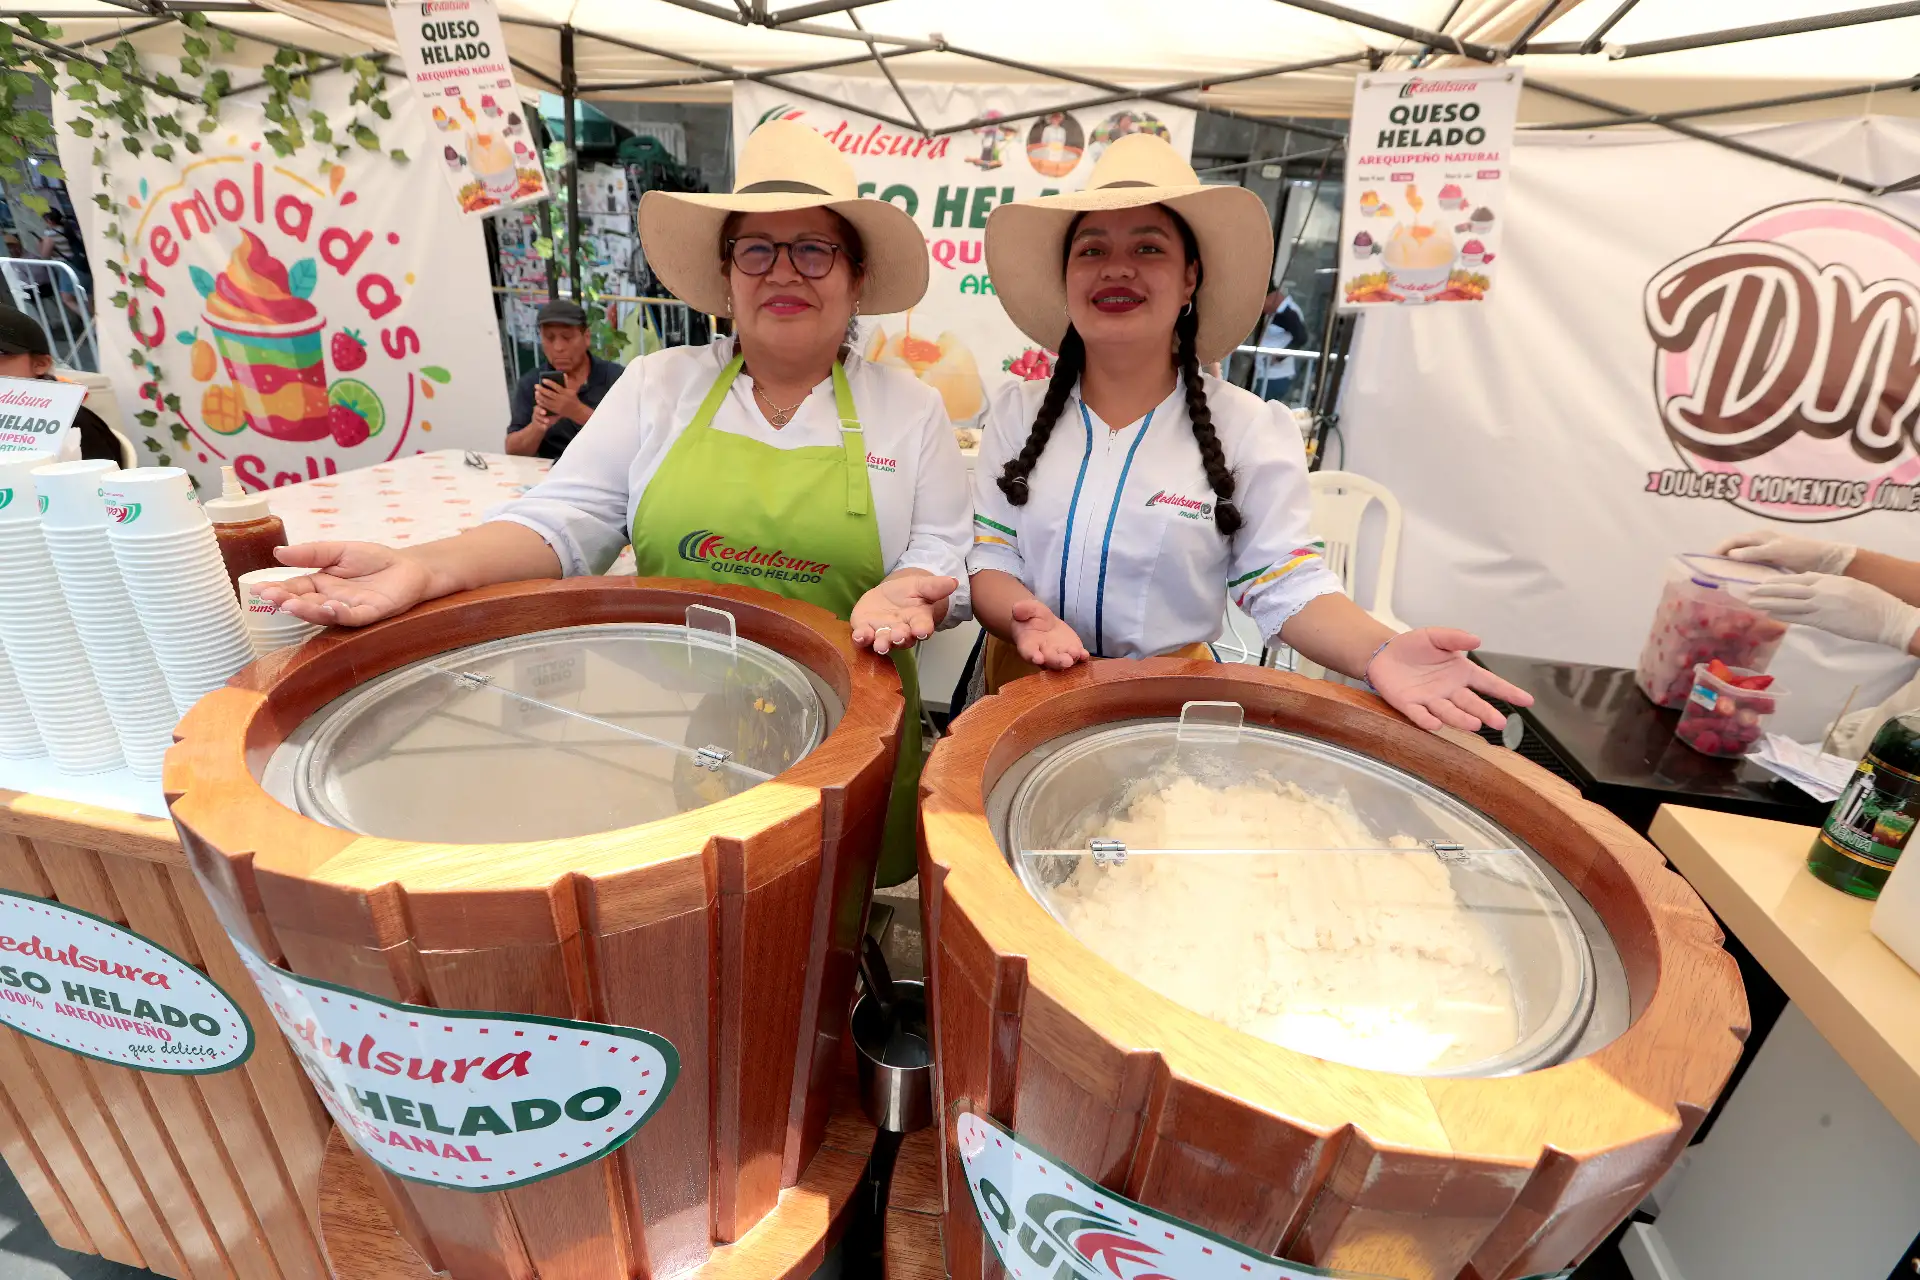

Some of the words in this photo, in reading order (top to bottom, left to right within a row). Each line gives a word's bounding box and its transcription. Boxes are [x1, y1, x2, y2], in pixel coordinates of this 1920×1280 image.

[421, 20, 480, 42] QUESO
[420, 41, 490, 65] HELADO
[1389, 102, 1481, 126] QUESO
[1377, 126, 1486, 149] HELADO
[1358, 154, 1440, 167] AREQUIPEÑO
[1657, 469, 1743, 501] DULCES
[1749, 474, 1868, 508] MOMENTOS
[699, 535, 831, 575] Kedulsura
[711, 561, 763, 577] QUESO
[763, 569, 822, 584] HELADO
[0, 935, 171, 990] edulsura
[61, 980, 222, 1037] HELADO
[54, 1001, 172, 1042] AREQUIPEÑO
[128, 1041, 154, 1057] que
[345, 1083, 623, 1137] HELADO
